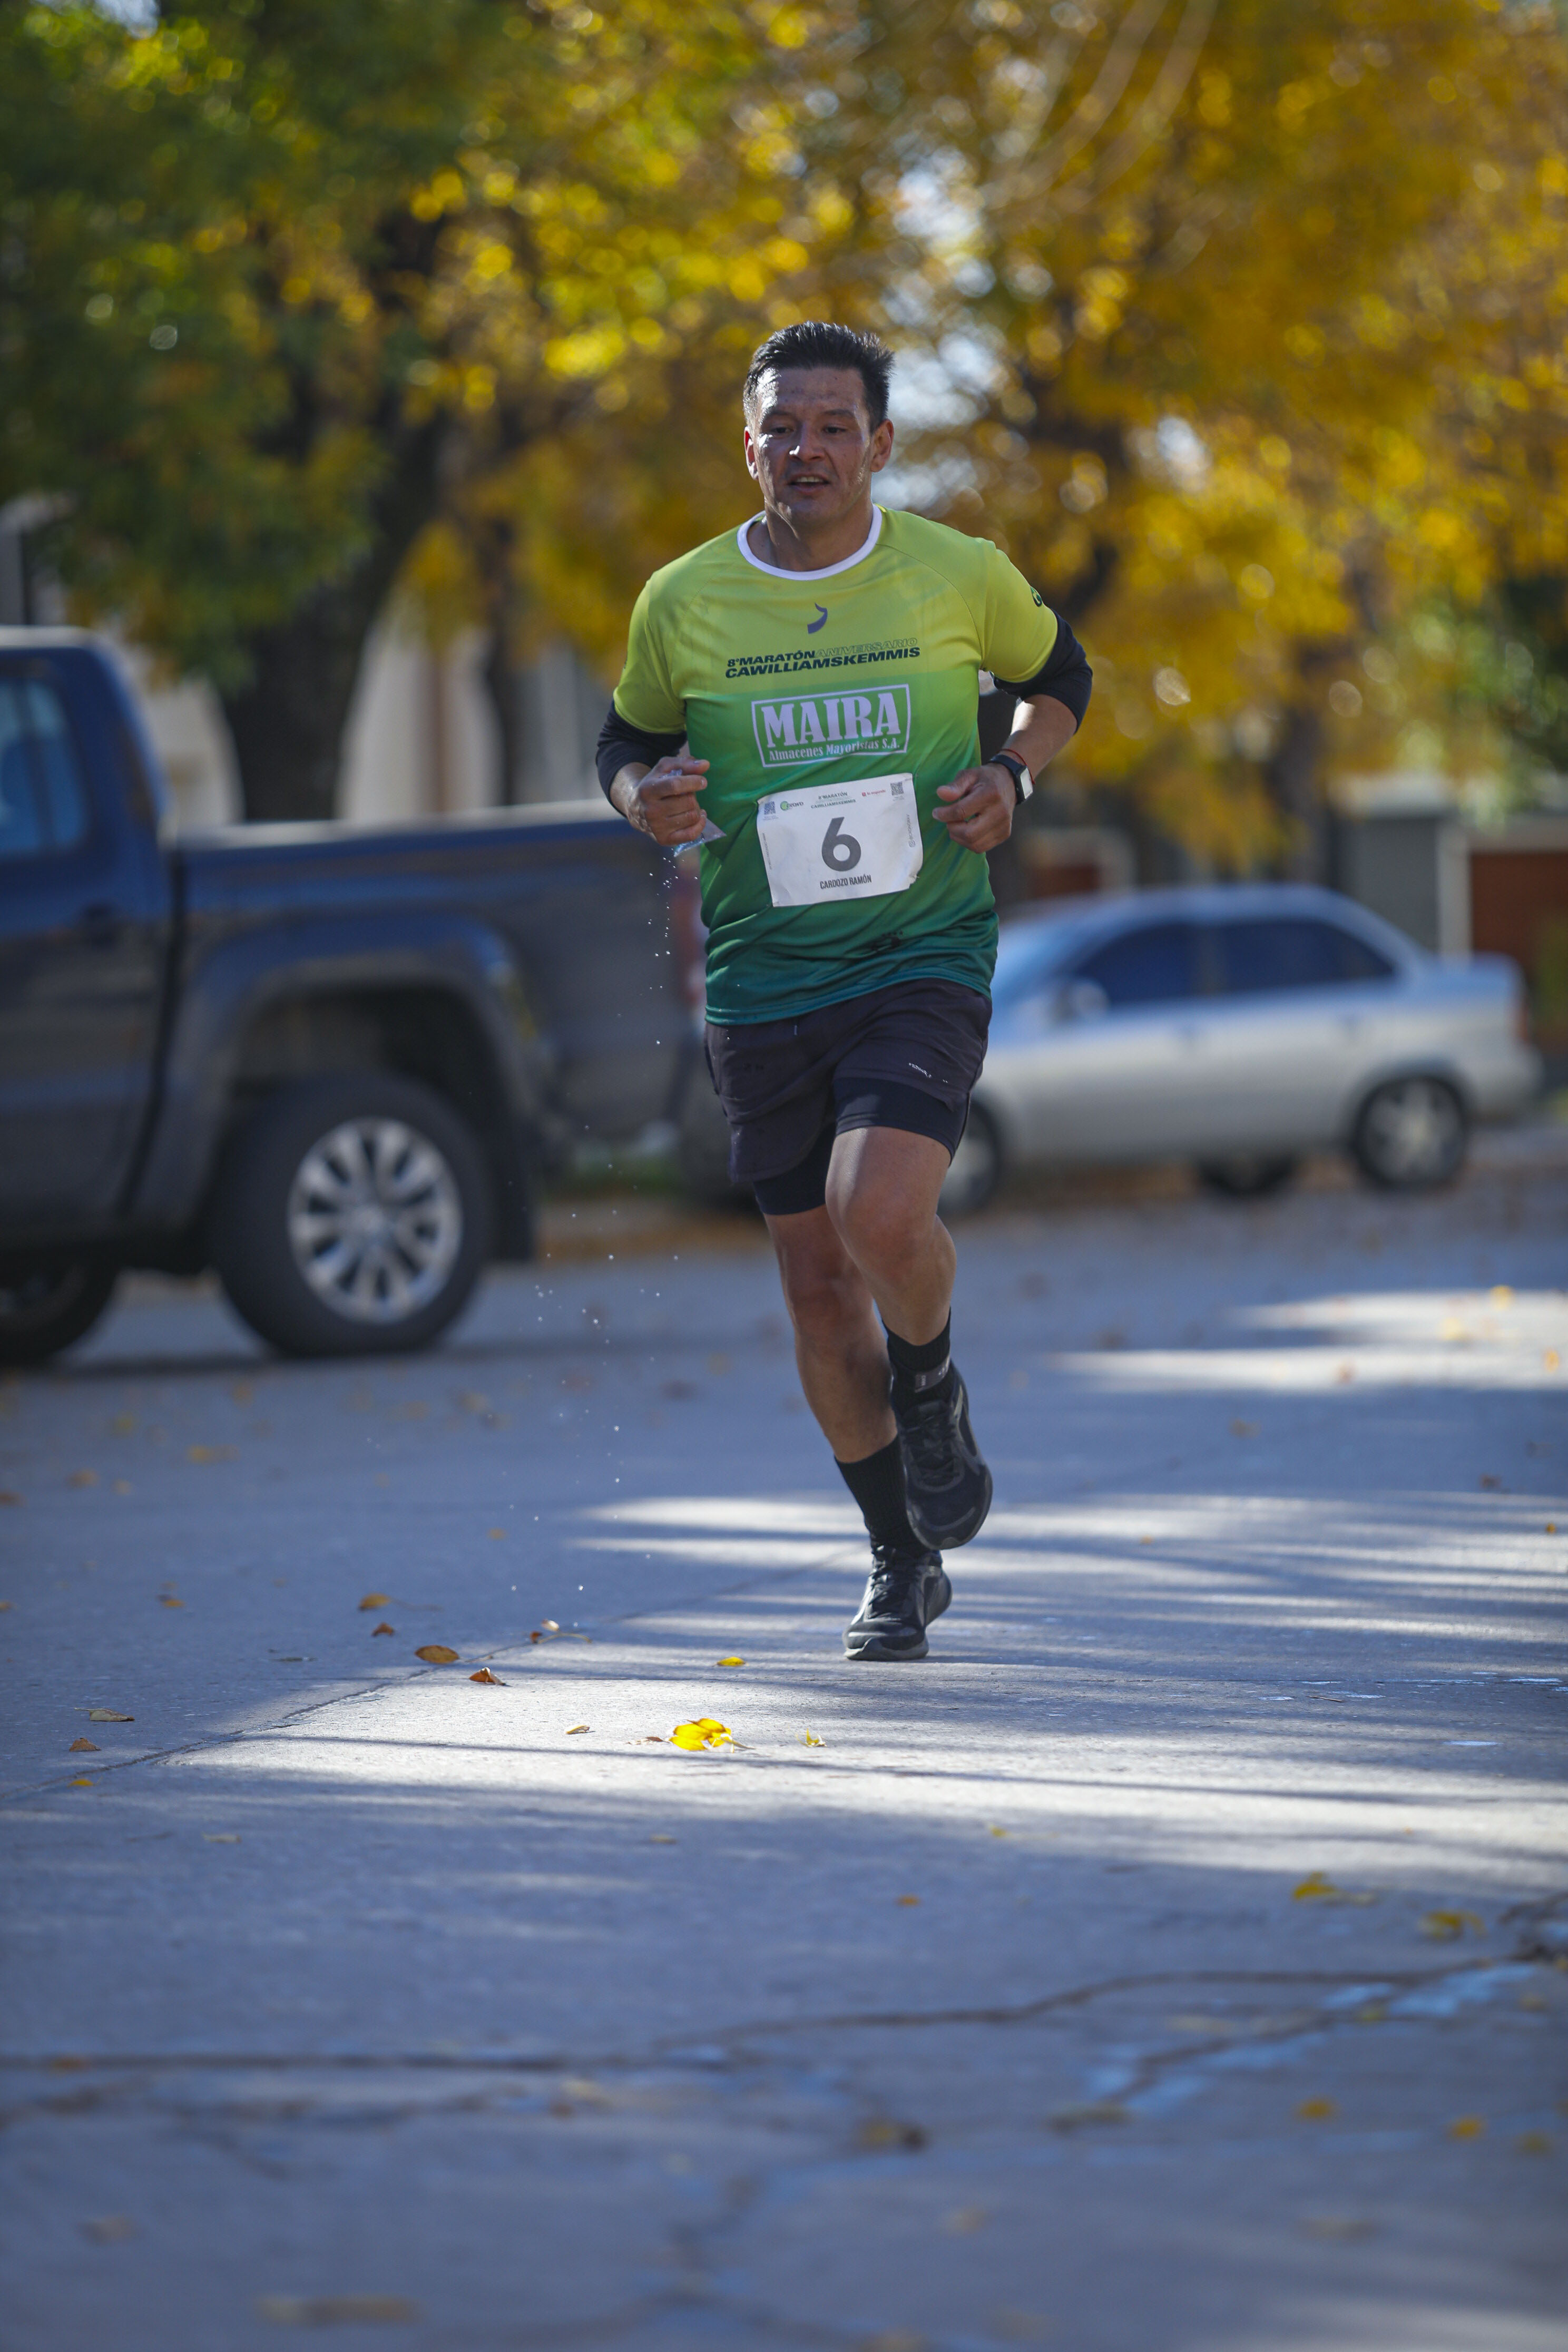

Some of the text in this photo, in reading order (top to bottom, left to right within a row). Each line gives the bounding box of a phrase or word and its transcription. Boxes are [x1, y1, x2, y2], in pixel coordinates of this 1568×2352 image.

[725, 646, 921, 679] CAWILLIAMSKEMMIS
[761, 692, 901, 748] MAIRA
[769, 738, 900, 761] Almacenes Mayoristas S.A.
[821, 817, 861, 872] 6
[820, 874, 872, 889] CARDOZO RAMÓN
